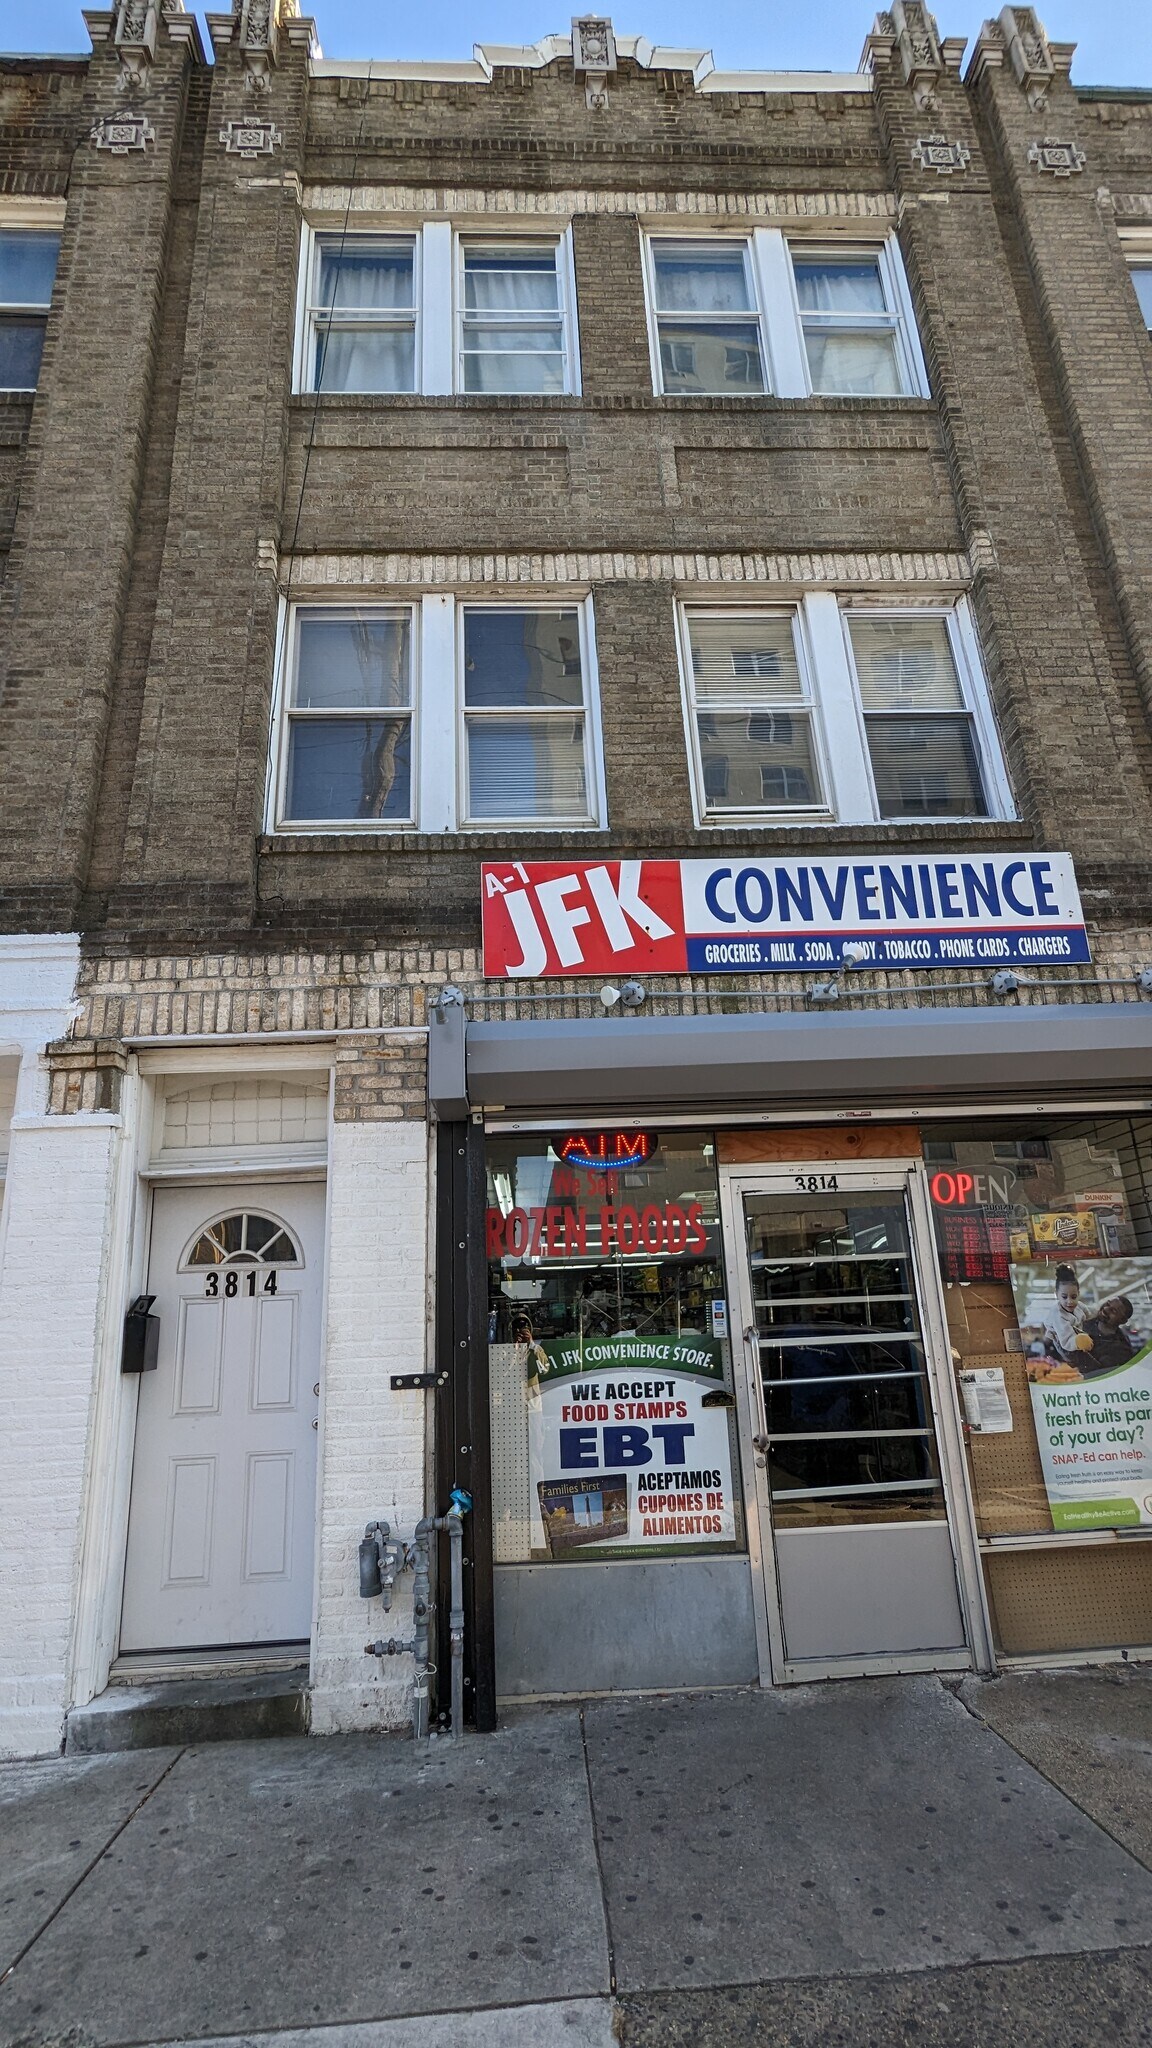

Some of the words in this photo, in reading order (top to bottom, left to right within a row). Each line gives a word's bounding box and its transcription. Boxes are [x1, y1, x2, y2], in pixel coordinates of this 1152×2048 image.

[485, 862, 530, 898] A-1
[704, 861, 1060, 924] CONVENIENCE
[503, 861, 676, 977] JFK
[705, 943, 760, 963] GROCERIES
[770, 942, 797, 962] MILK
[805, 942, 834, 961] SODA
[842, 941, 876, 960] CDY
[884, 939, 931, 959] TOBACCO
[939, 938, 975, 958] PHONE
[976, 937, 1010, 957] CARDS
[1018, 936, 1071, 955] CHARGERS
[553, 1168, 581, 1196] We
[587, 1167, 619, 1196] Sell
[794, 1175, 839, 1192] 3814
[931, 1172, 1010, 1205] OPEN
[486, 1205, 587, 1258] ROZEN
[600, 1201, 707, 1255] FOODS
[205, 1271, 277, 1298] 3814
[562, 1349, 583, 1367] JFK
[585, 1344, 669, 1361] CONVENIENCE
[571, 1384, 600, 1401] WE
[605, 1381, 676, 1400] ACCEPT
[1042, 1391, 1081, 1408] Want
[1085, 1390, 1100, 1405] to
[1105, 1387, 1151, 1403] make
[562, 1404, 609, 1422] FOOD
[614, 1401, 687, 1420] STAMPS
[1045, 1411, 1082, 1427] fresh
[1085, 1408, 1122, 1424] fruits
[1125, 1408, 1152, 1425] par
[559, 1423, 695, 1469] EBT
[1049, 1431, 1064, 1446] of
[1068, 1431, 1101, 1449] your
[1106, 1425, 1144, 1444] day?
[1052, 1452, 1096, 1465] SNAP-Ed
[1098, 1451, 1118, 1461] can
[1120, 1449, 1146, 1461] help.
[541, 1484, 579, 1496] Families
[580, 1481, 601, 1492] First
[637, 1470, 722, 1491] ACEPTAMOS
[638, 1493, 703, 1514] CUPONES
[706, 1492, 724, 1511] DE
[642, 1515, 722, 1536] ALIMENTOS
[1063, 1509, 1136, 1521] EatHealthyBeActive.com
